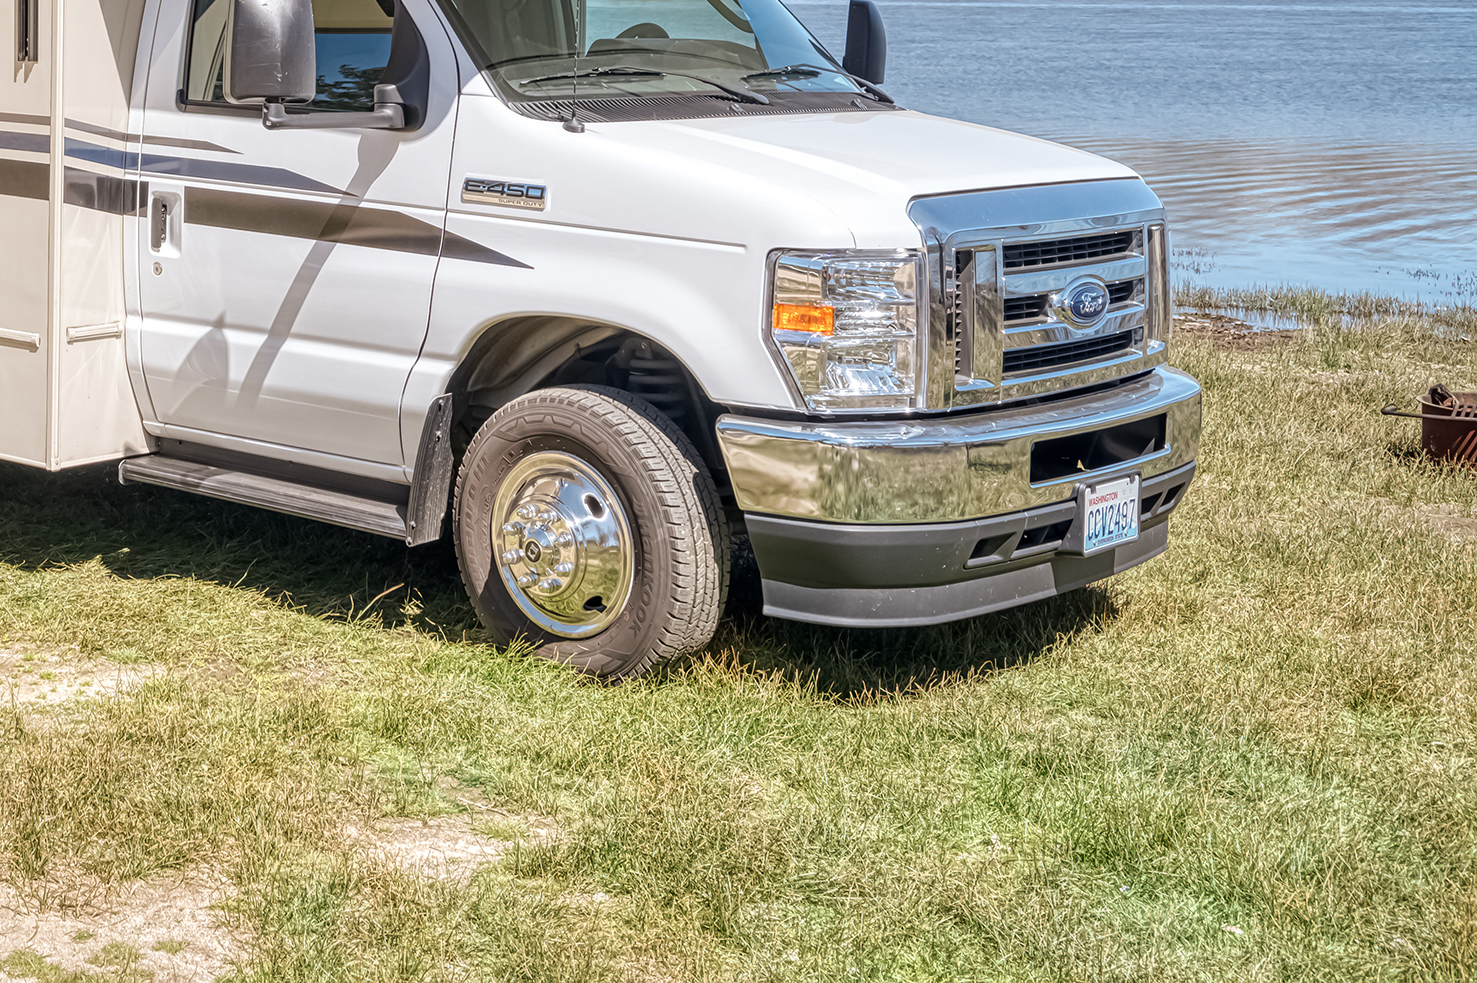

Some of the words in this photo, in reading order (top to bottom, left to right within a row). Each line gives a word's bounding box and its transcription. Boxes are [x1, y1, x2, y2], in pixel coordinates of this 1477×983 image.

[464, 179, 545, 200] E-450
[498, 198, 522, 206] SUPER
[1079, 292, 1104, 315] Ford
[1088, 491, 1119, 507] WASHINGTON
[1087, 498, 1136, 542] CCV2497
